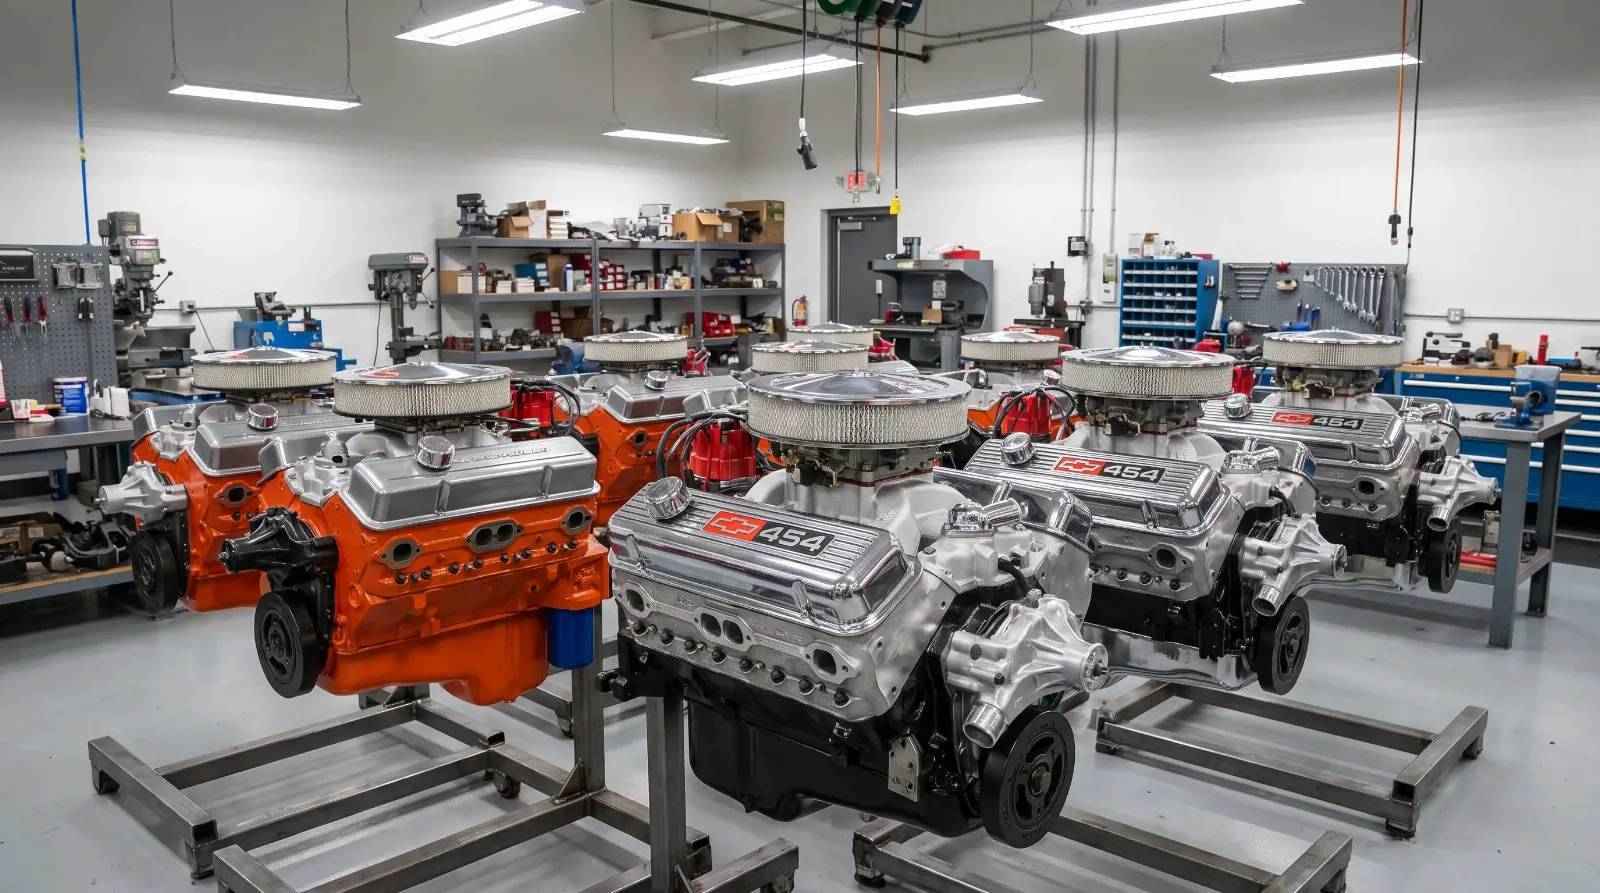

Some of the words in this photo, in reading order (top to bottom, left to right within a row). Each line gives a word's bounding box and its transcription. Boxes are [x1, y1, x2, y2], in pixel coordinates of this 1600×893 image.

[848, 173, 864, 189] ET
[1313, 416, 1359, 429] 454
[1104, 465, 1160, 481] 454
[758, 526, 826, 553] 454
